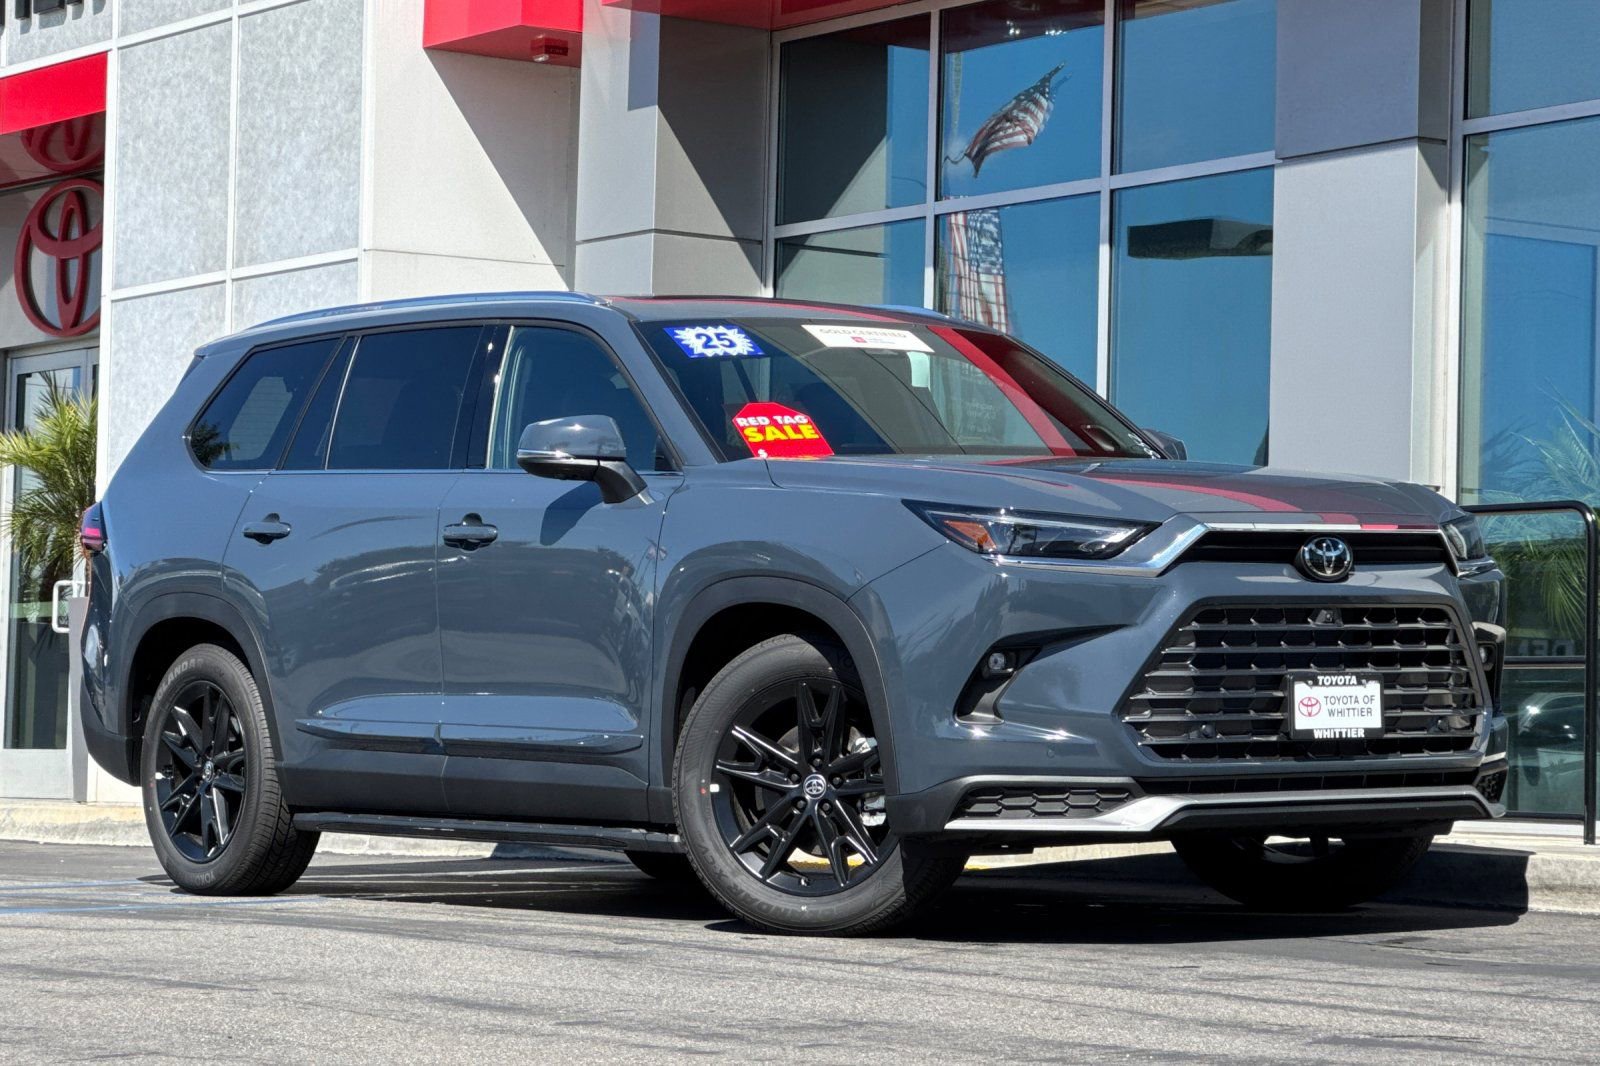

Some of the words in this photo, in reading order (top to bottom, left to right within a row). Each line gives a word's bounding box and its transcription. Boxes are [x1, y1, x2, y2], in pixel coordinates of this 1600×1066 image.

[695, 333, 737, 349] 25
[735, 415, 770, 427] RED
[772, 414, 809, 425] TAG
[743, 424, 820, 443] SALE
[1317, 675, 1358, 686] TOYOTA
[1323, 695, 1360, 706] TOYOTA
[1362, 694, 1376, 705] OF
[1327, 707, 1373, 718] WHITTIER
[1313, 728, 1365, 739] WHITTIER
